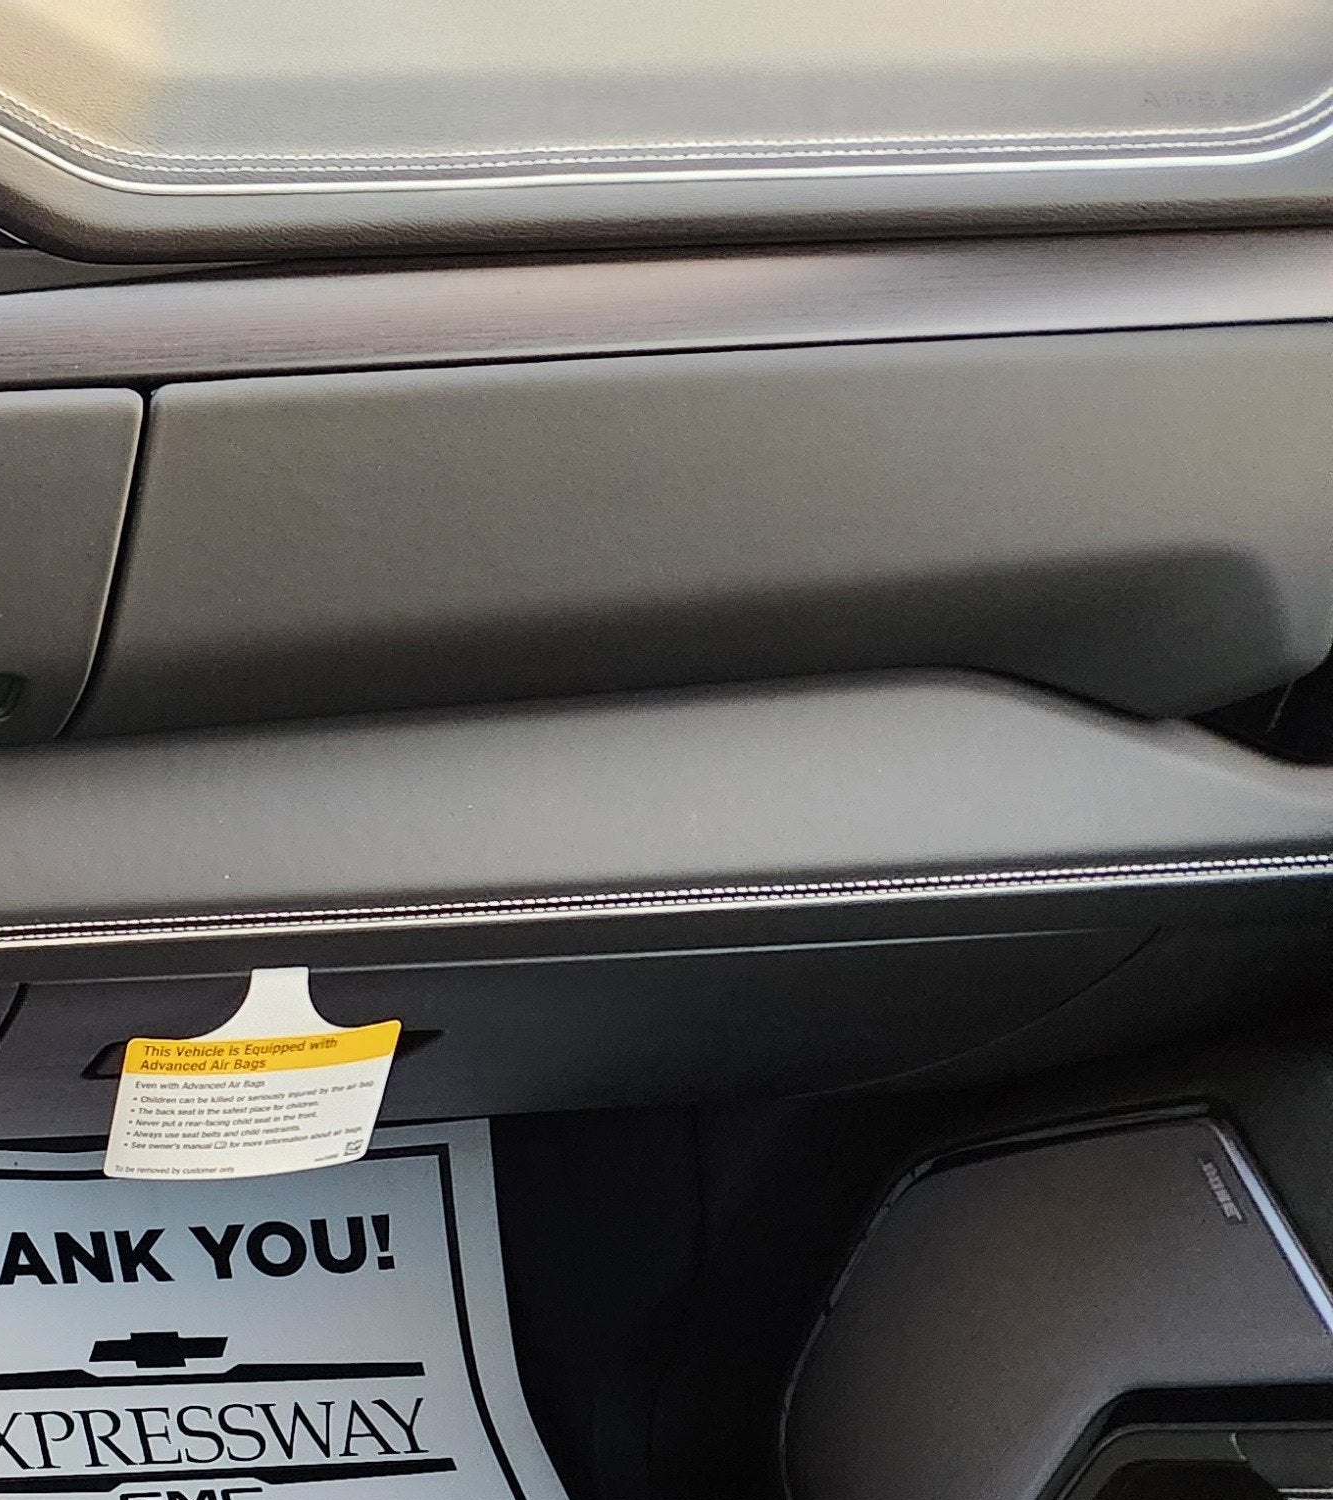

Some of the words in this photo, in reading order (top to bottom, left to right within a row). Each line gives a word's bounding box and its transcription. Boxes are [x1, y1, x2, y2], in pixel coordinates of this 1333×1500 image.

[144, 1045, 171, 1057] This
[176, 1045, 225, 1057] Vehicle
[229, 1046, 240, 1056] is
[244, 1041, 306, 1056] Equipped
[309, 1037, 338, 1050] with
[140, 1060, 207, 1072] Advanced
[207, 1060, 230, 1071] Air
[233, 1058, 267, 1071] Bags
[134, 1081, 157, 1089] Even
[160, 1081, 180, 1090] with
[181, 1081, 227, 1090] Advanced
[228, 1080, 241, 1088] Air
[244, 1079, 265, 1089] Bags
[140, 1095, 177, 1104] Children
[197, 1096, 208, 1104] be
[211, 1095, 235, 1103] killed
[138, 1107, 153, 1115] The
[155, 1107, 175, 1116] back
[177, 1107, 197, 1116] seat
[207, 1107, 221, 1115] the
[249, 1106, 271, 1114] place
[135, 1119, 160, 1127] Never
[161, 1119, 176, 1128] put
[133, 1130, 162, 1139] Always
[181, 1131, 200, 1139] seat
[131, 1141, 146, 1149] See
[189, 1214, 396, 1280] YOU!
